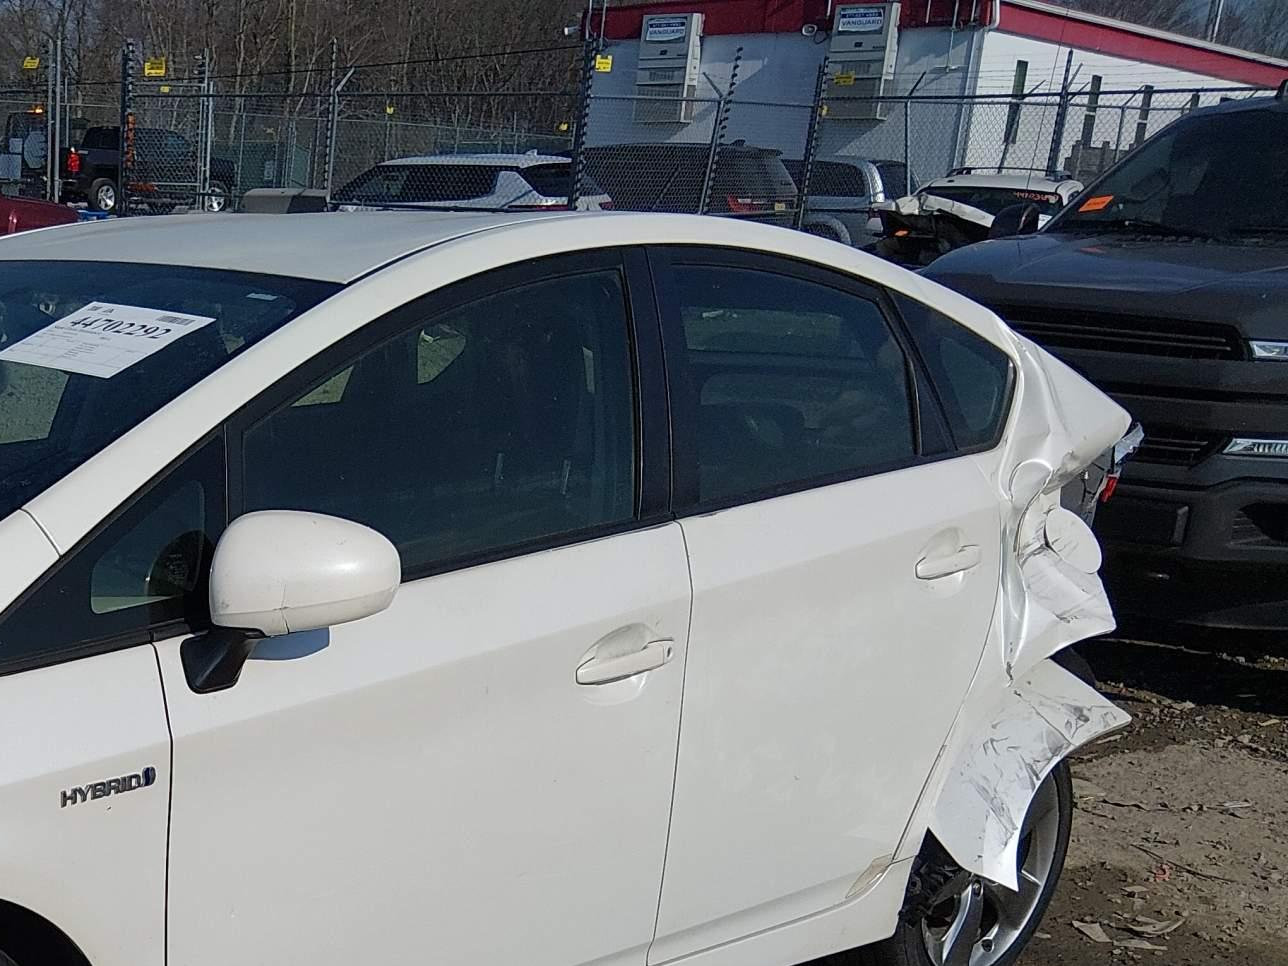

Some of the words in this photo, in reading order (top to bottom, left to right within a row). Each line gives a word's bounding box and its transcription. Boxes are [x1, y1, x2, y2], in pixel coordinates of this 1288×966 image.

[841, 18, 882, 26] VANGUARD
[70, 316, 172, 339] 44702292
[60, 773, 142, 808] HYBRID
